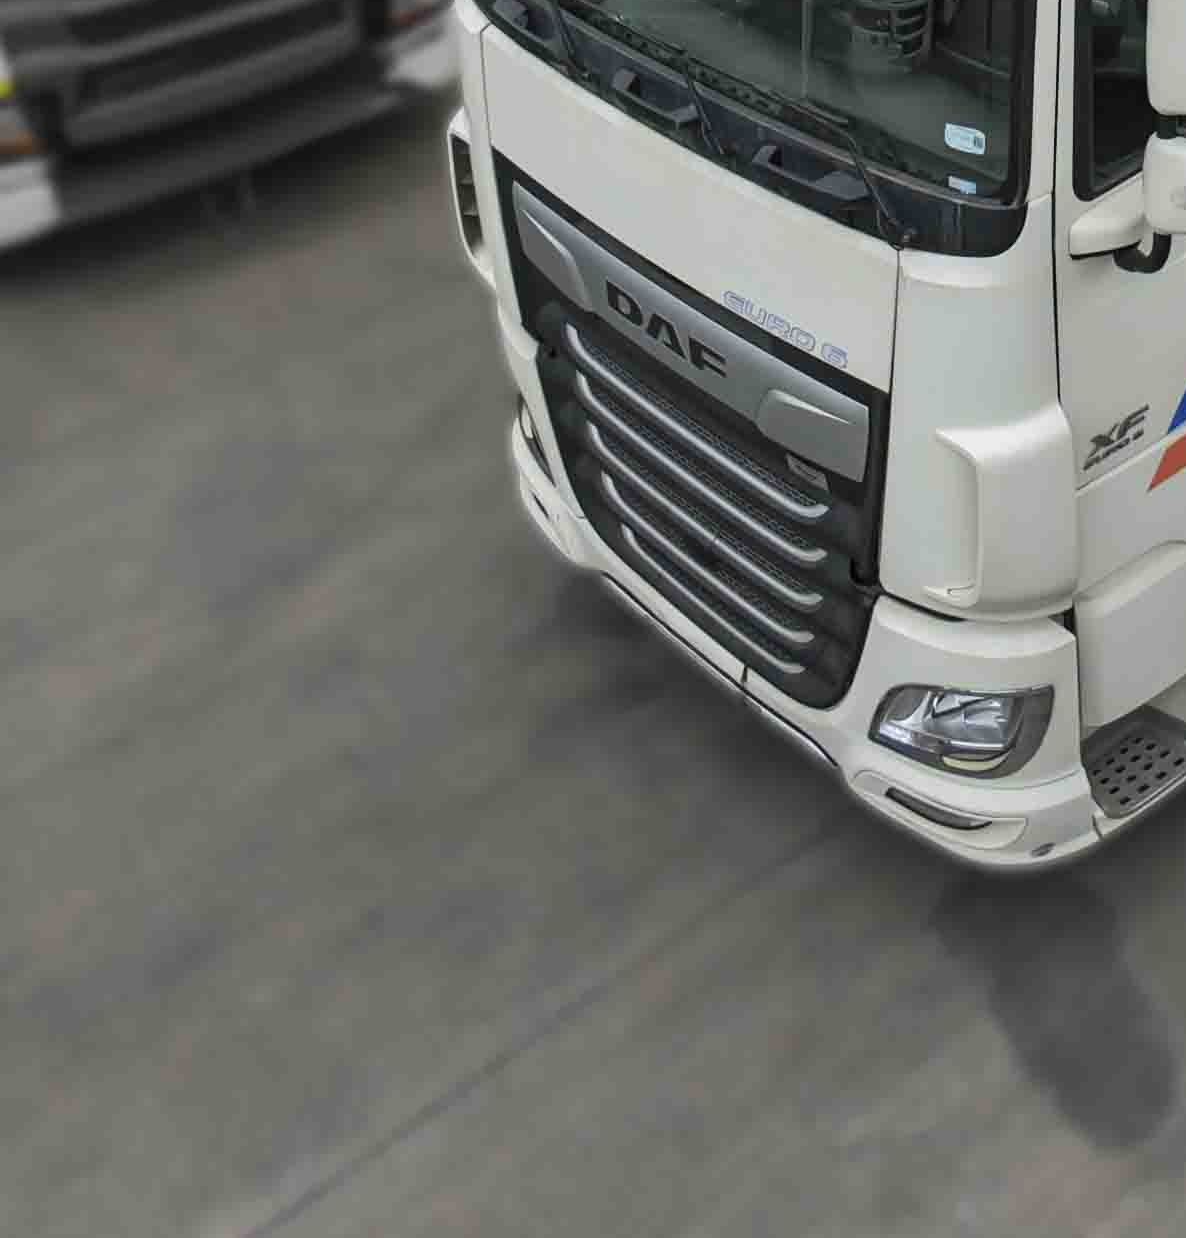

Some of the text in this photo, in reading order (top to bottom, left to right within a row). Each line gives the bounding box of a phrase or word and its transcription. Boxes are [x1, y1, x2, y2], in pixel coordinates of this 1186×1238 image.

[606, 280, 728, 378] DAF
[722, 290, 816, 352] EURO
[1088, 403, 1149, 459] XF
